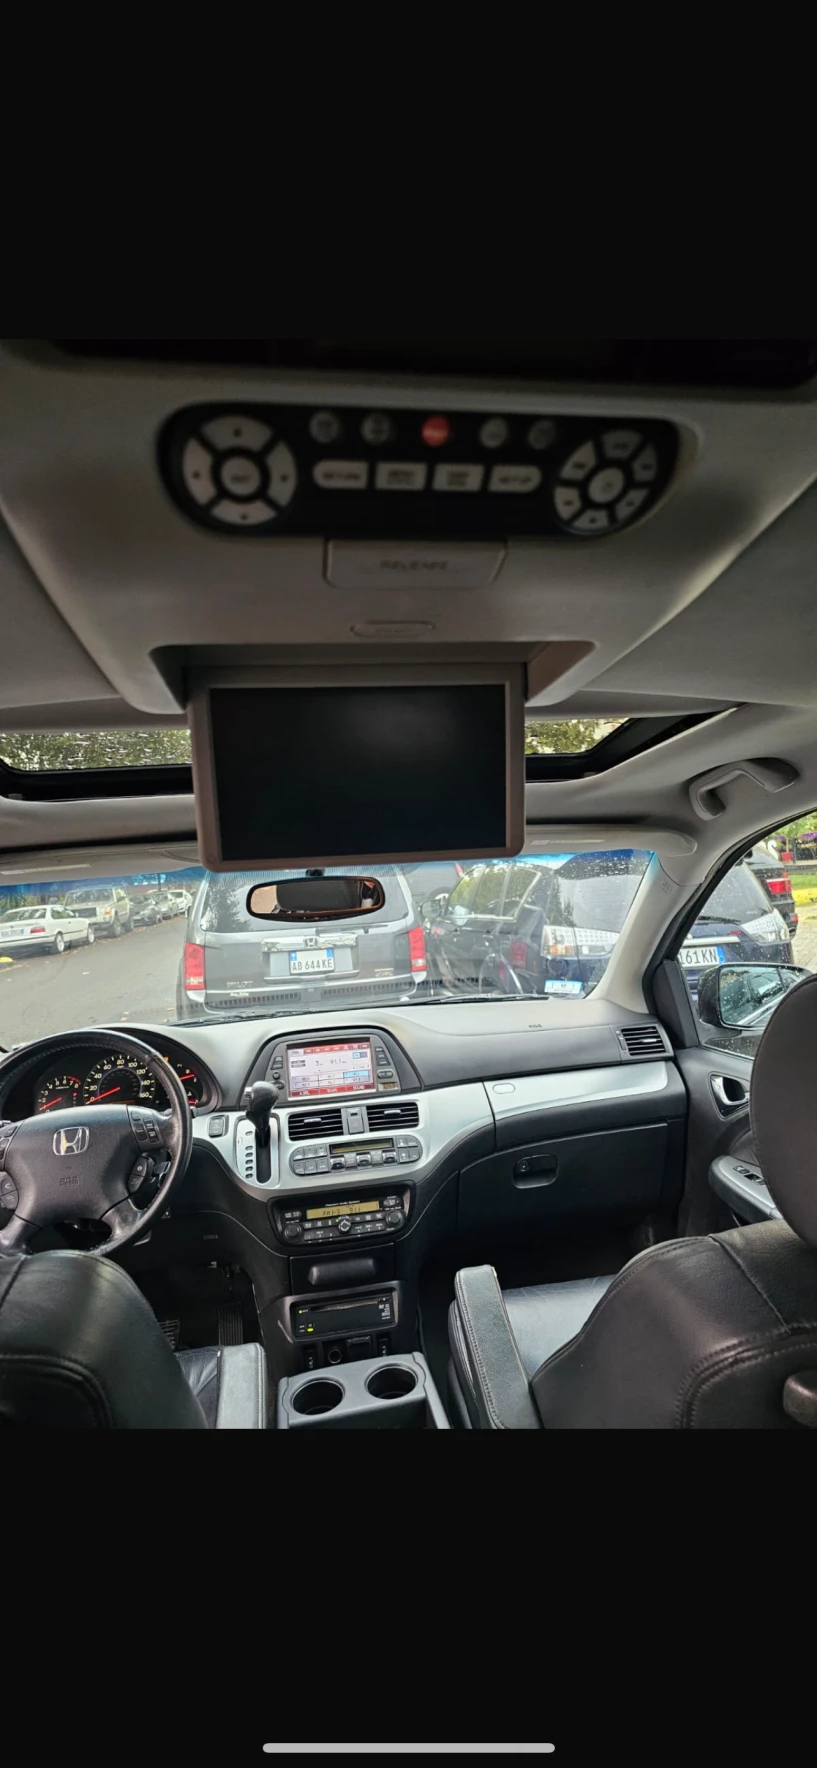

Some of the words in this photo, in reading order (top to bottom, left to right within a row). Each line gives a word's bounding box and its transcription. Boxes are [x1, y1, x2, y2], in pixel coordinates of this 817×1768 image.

[292, 961, 303, 972] AB
[304, 960, 320, 970] 644
[322, 958, 333, 969] KE
